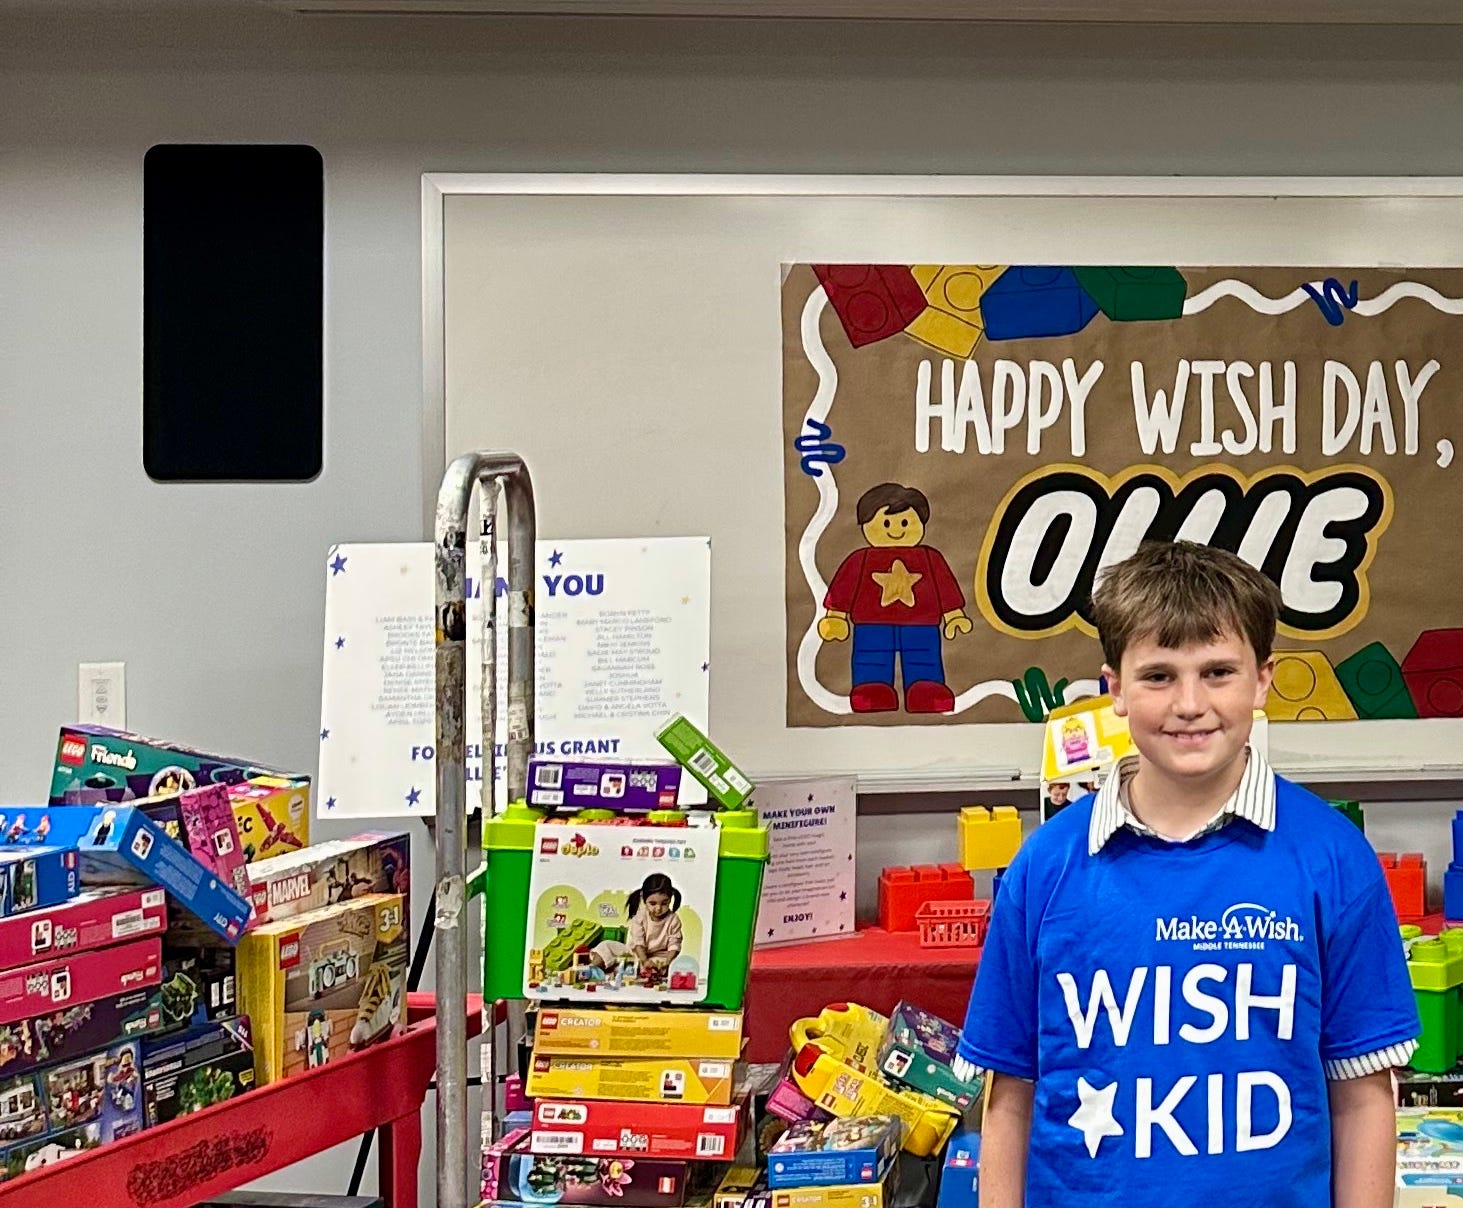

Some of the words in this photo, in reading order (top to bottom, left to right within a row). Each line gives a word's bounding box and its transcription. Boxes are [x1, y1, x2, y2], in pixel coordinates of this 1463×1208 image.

[915, 359, 1103, 456] HAPPY
[1131, 360, 1297, 456] WISH
[1322, 359, 1454, 469] DAY,
[543, 574, 604, 596] YOU
[62, 742, 86, 758] LEGO
[91, 744, 137, 770] Friends
[412, 747, 435, 760] FO
[560, 740, 620, 754] GRANT
[763, 809, 788, 820] MAKE
[790, 807, 812, 818] YOUR
[814, 805, 835, 815] OWN
[773, 818, 827, 830] MINIFIGURE!
[271, 872, 311, 906] MARVEL
[784, 912, 813, 924] ENJOY!
[1193, 942, 1222, 950] MIDDLE
[1224, 942, 1265, 950] TENNESSEE
[1057, 963, 1297, 1048] WISH
[561, 1017, 601, 1026] CREATOR
[1135, 1071, 1292, 1158] KID
